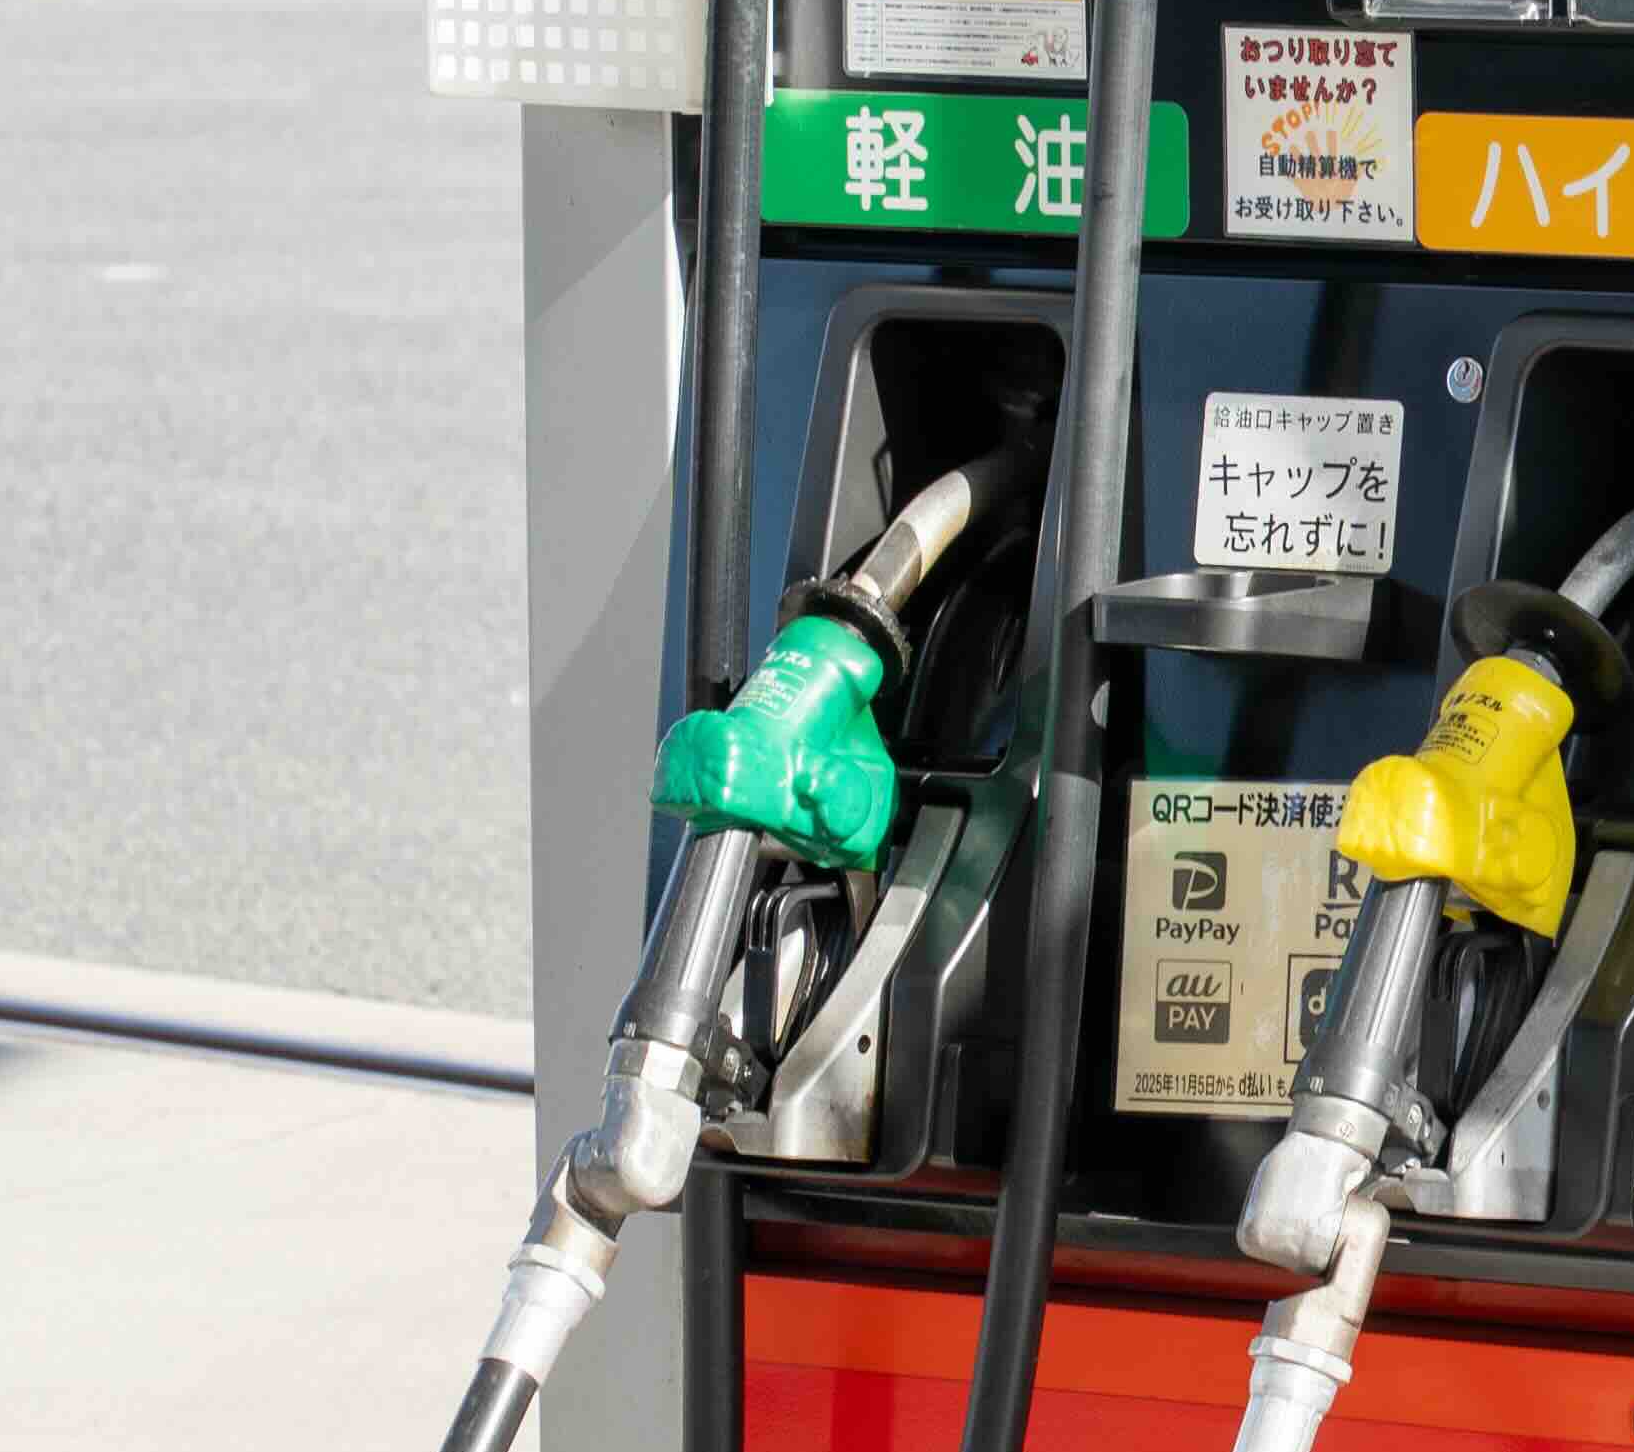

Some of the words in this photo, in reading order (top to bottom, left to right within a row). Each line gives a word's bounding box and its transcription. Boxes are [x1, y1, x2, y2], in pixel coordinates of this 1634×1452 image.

[1243, 76, 1378, 105] いませんか?
[844, 104, 1088, 218] 軽油
[1258, 153, 1378, 181] 自動精算機で
[1234, 195, 1404, 228] お受け取り下さい。
[1213, 407, 1395, 436] 給油口キャップ置き
[1208, 452, 1389, 503] キャップを
[1223, 510, 1388, 561] 忘れずに!
[1155, 916, 1240, 946] PayPay
[1166, 970, 1222, 999] au
[1168, 1005, 1216, 1031] PAY
